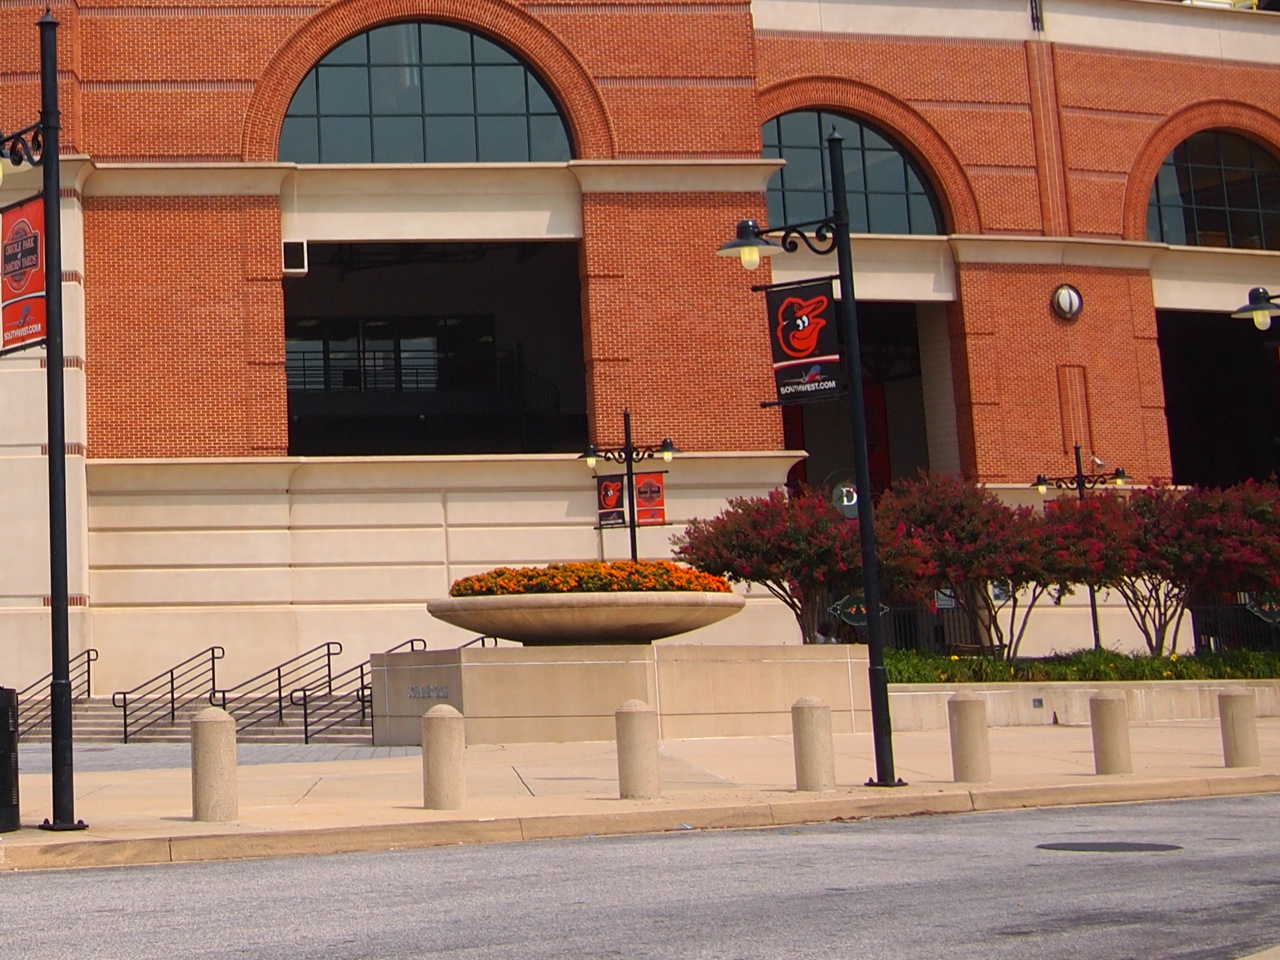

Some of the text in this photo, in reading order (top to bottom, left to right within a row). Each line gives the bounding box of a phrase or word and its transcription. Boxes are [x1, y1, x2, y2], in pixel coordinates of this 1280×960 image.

[4, 323, 42, 341] SOUTHWEST.COM
[780, 380, 836, 395] SOUTHWEST.COM
[841, 487, 858, 506] D
